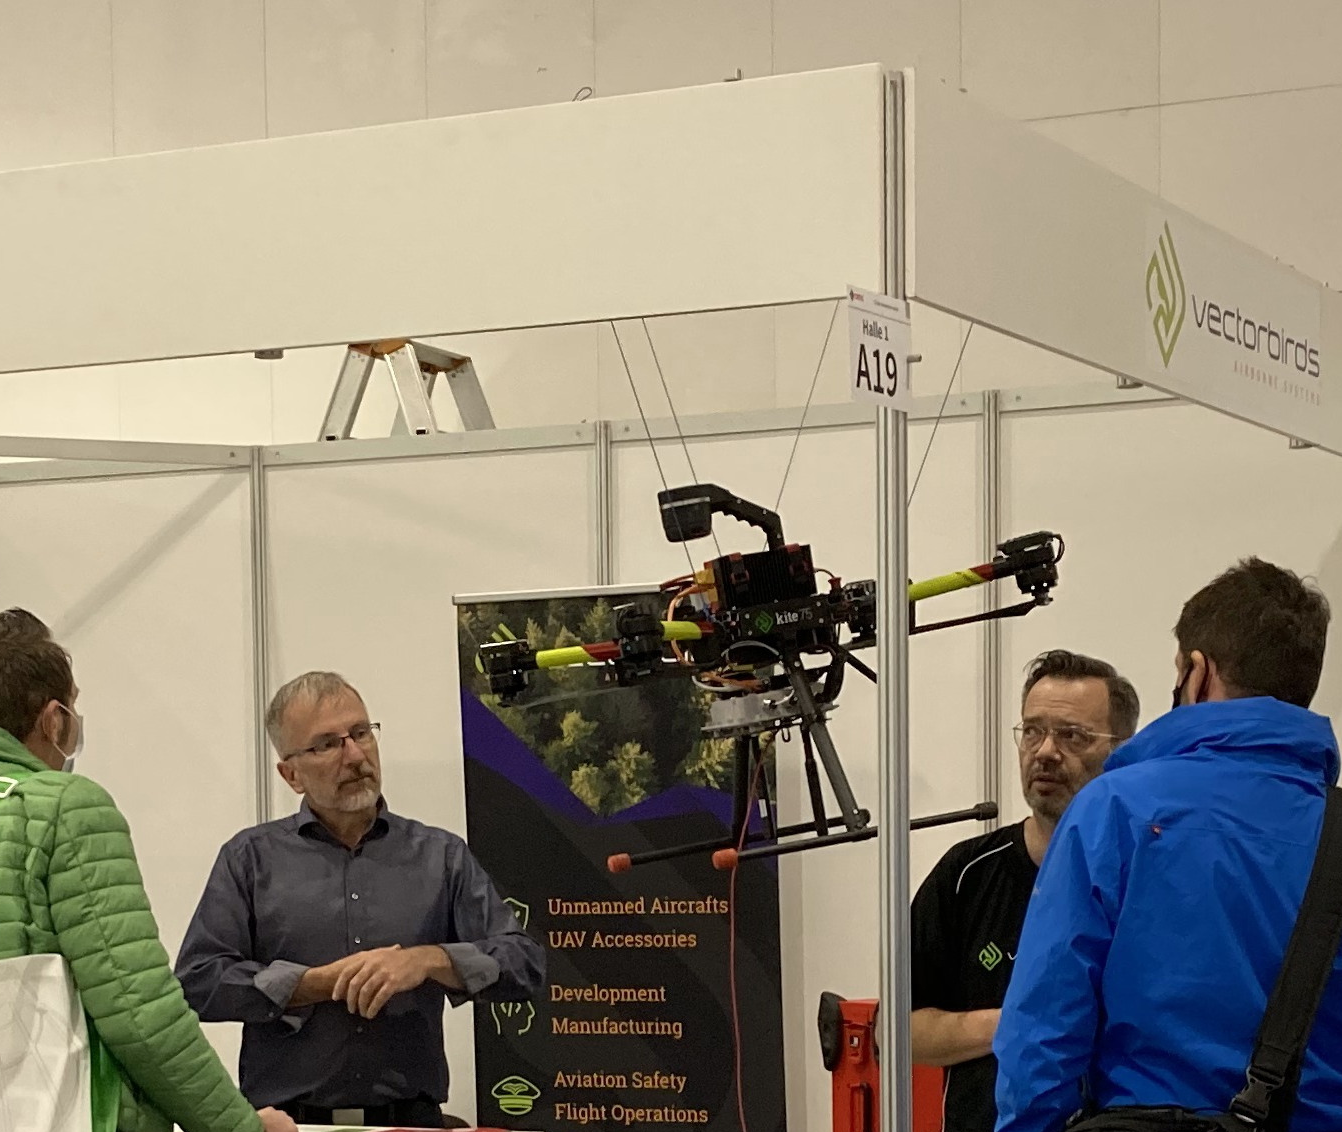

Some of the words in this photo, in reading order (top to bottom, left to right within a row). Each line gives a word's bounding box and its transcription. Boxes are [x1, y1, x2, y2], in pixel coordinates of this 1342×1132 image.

[862, 318, 883, 340] Halle
[884, 325, 889, 341] 1
[1192, 294, 1319, 378] vectorbirds
[856, 343, 898, 397] A19
[548, 897, 646, 915] Unmanned
[650, 896, 729, 914] Aircrafts
[548, 931, 585, 948] UAV
[592, 930, 697, 948] Accessories
[550, 984, 666, 1005] Development
[551, 1017, 683, 1039] Manufacturing
[553, 1071, 627, 1089] Aviation
[632, 1071, 687, 1093] Safety
[554, 1103, 607, 1123] Flight
[611, 1104, 708, 1125] Operations
